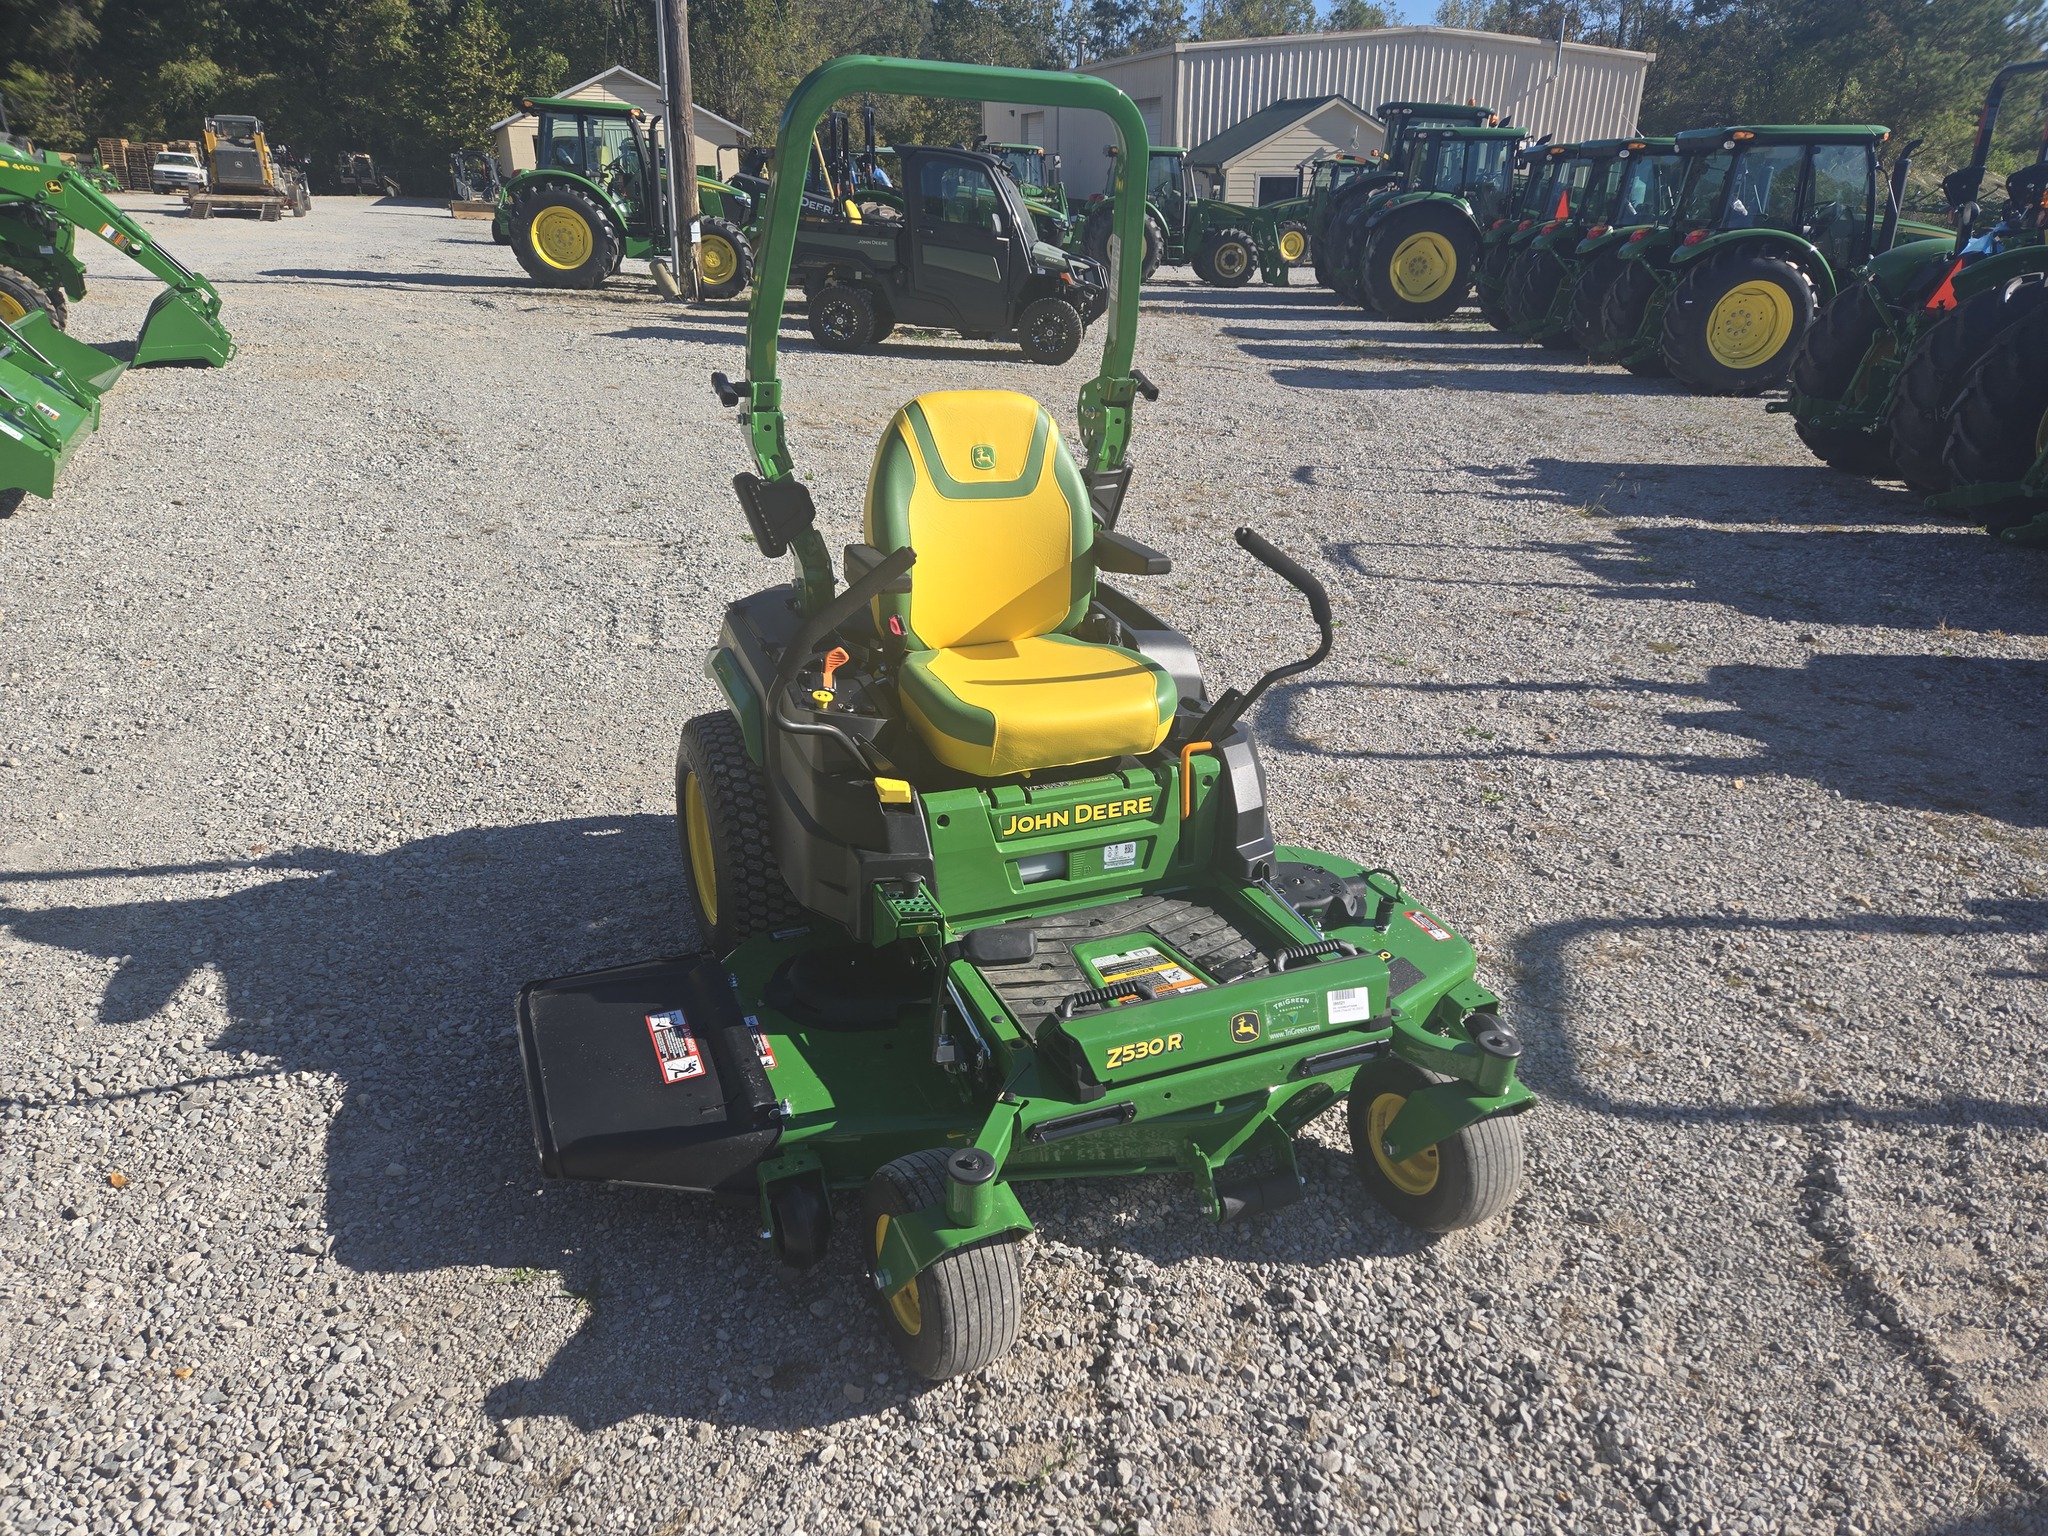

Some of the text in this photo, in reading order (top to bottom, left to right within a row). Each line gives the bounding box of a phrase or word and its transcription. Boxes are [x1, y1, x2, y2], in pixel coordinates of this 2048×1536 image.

[801, 197, 834, 214] DEER
[1003, 796, 1153, 836] JOHN DEERE
[1269, 1024, 1320, 1040] www.TriGreen.com
